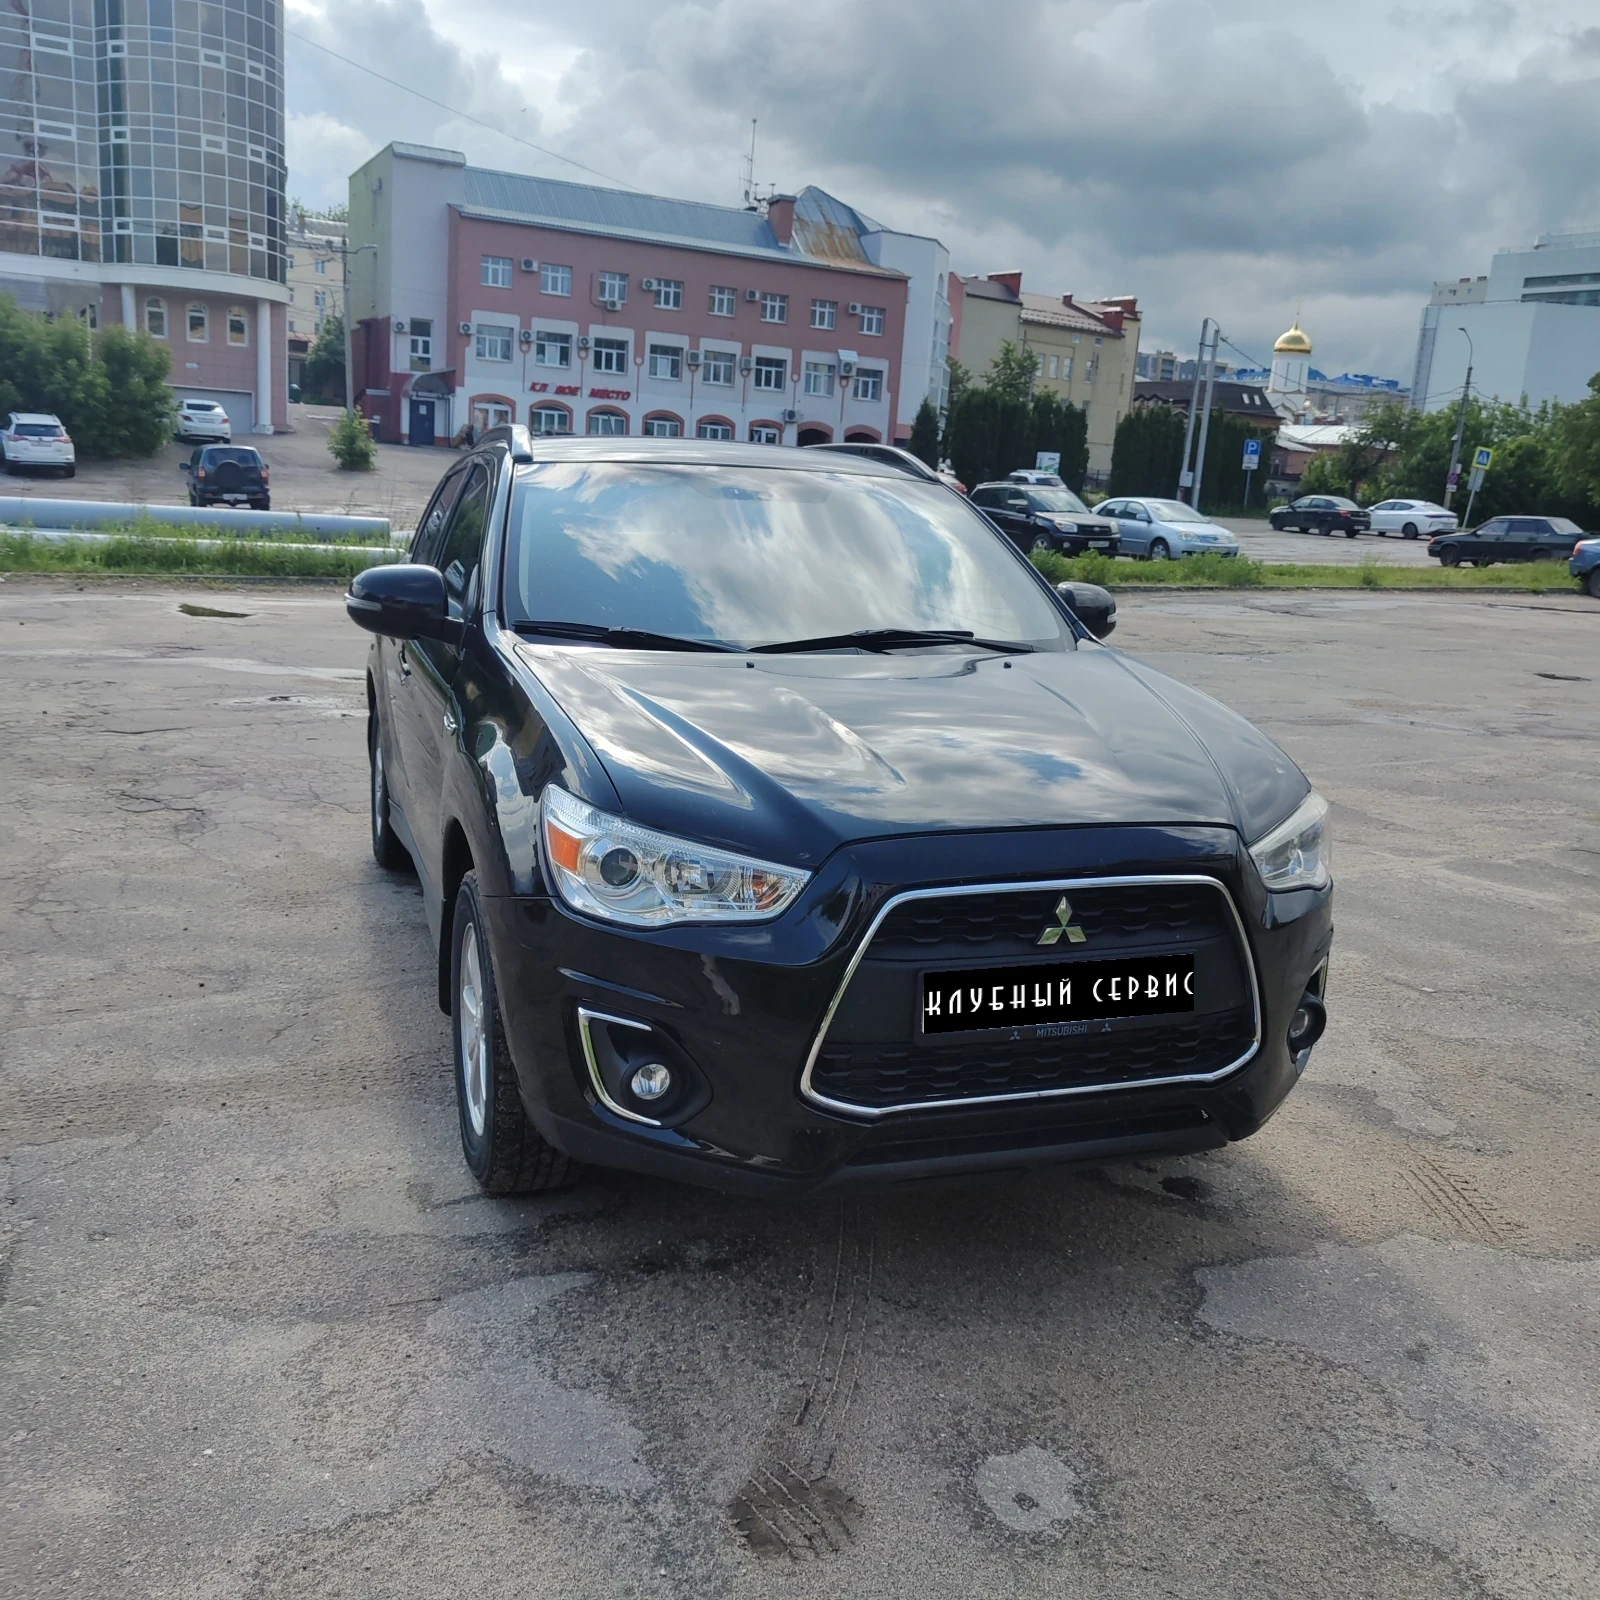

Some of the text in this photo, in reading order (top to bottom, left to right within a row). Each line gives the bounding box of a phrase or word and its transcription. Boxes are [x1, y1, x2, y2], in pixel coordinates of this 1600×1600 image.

[529, 381, 631, 401] КЛВОЕ МЕСТО
[1247, 442, 1258, 454] P
[1035, 1024, 1088, 1038] MITSUBISHI
